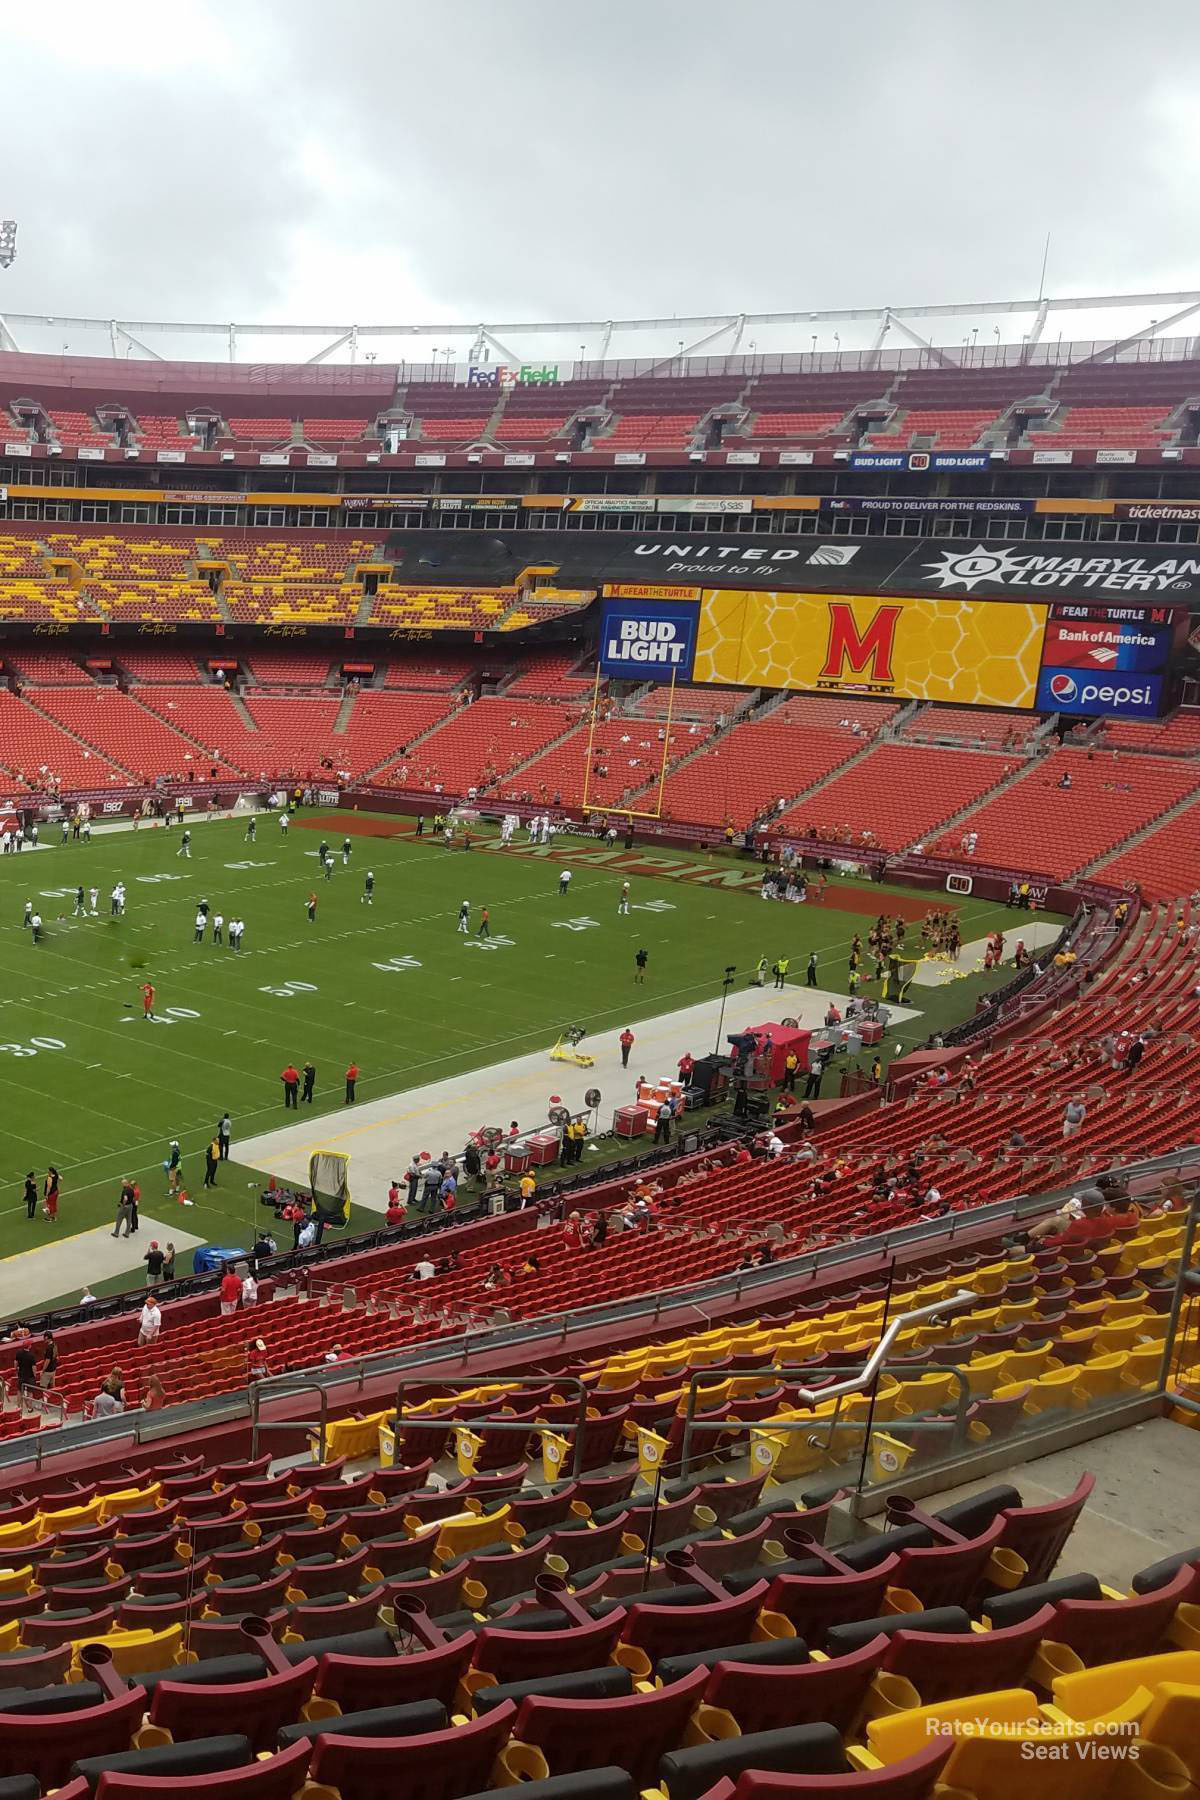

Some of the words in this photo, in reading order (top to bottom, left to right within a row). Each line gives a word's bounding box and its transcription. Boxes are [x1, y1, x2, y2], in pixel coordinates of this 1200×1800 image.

[854, 458, 874, 466] BUD
[875, 458, 903, 466] LIGHT
[912, 456, 927, 467] 40
[935, 457, 956, 466] BUD
[957, 457, 986, 466] LIGHT
[861, 501, 891, 510] PROUD
[892, 502, 902, 510] TO
[903, 502, 938, 510] DELIVER
[940, 502, 958, 510] FOR
[959, 502, 975, 510] THE
[976, 502, 1022, 511] REDSKINS.
[634, 545, 800, 560] UNITED
[666, 562, 724, 573] Proud
[727, 564, 749, 573] to
[752, 565, 782, 576] fly
[1021, 556, 1200, 575] MARYLAN
[620, 621, 677, 642] BUD
[1058, 628, 1090, 642] Bank
[1091, 631, 1103, 642] of
[1103, 632, 1156, 646] America
[607, 641, 686, 663] LIGHT
[1081, 685, 1153, 707] pepsi
[103, 801, 123, 812] 1987
[951, 879, 968, 892] 40
[463, 936, 517, 951] 30
[370, 957, 423, 972] 40
[257, 981, 318, 997] 50
